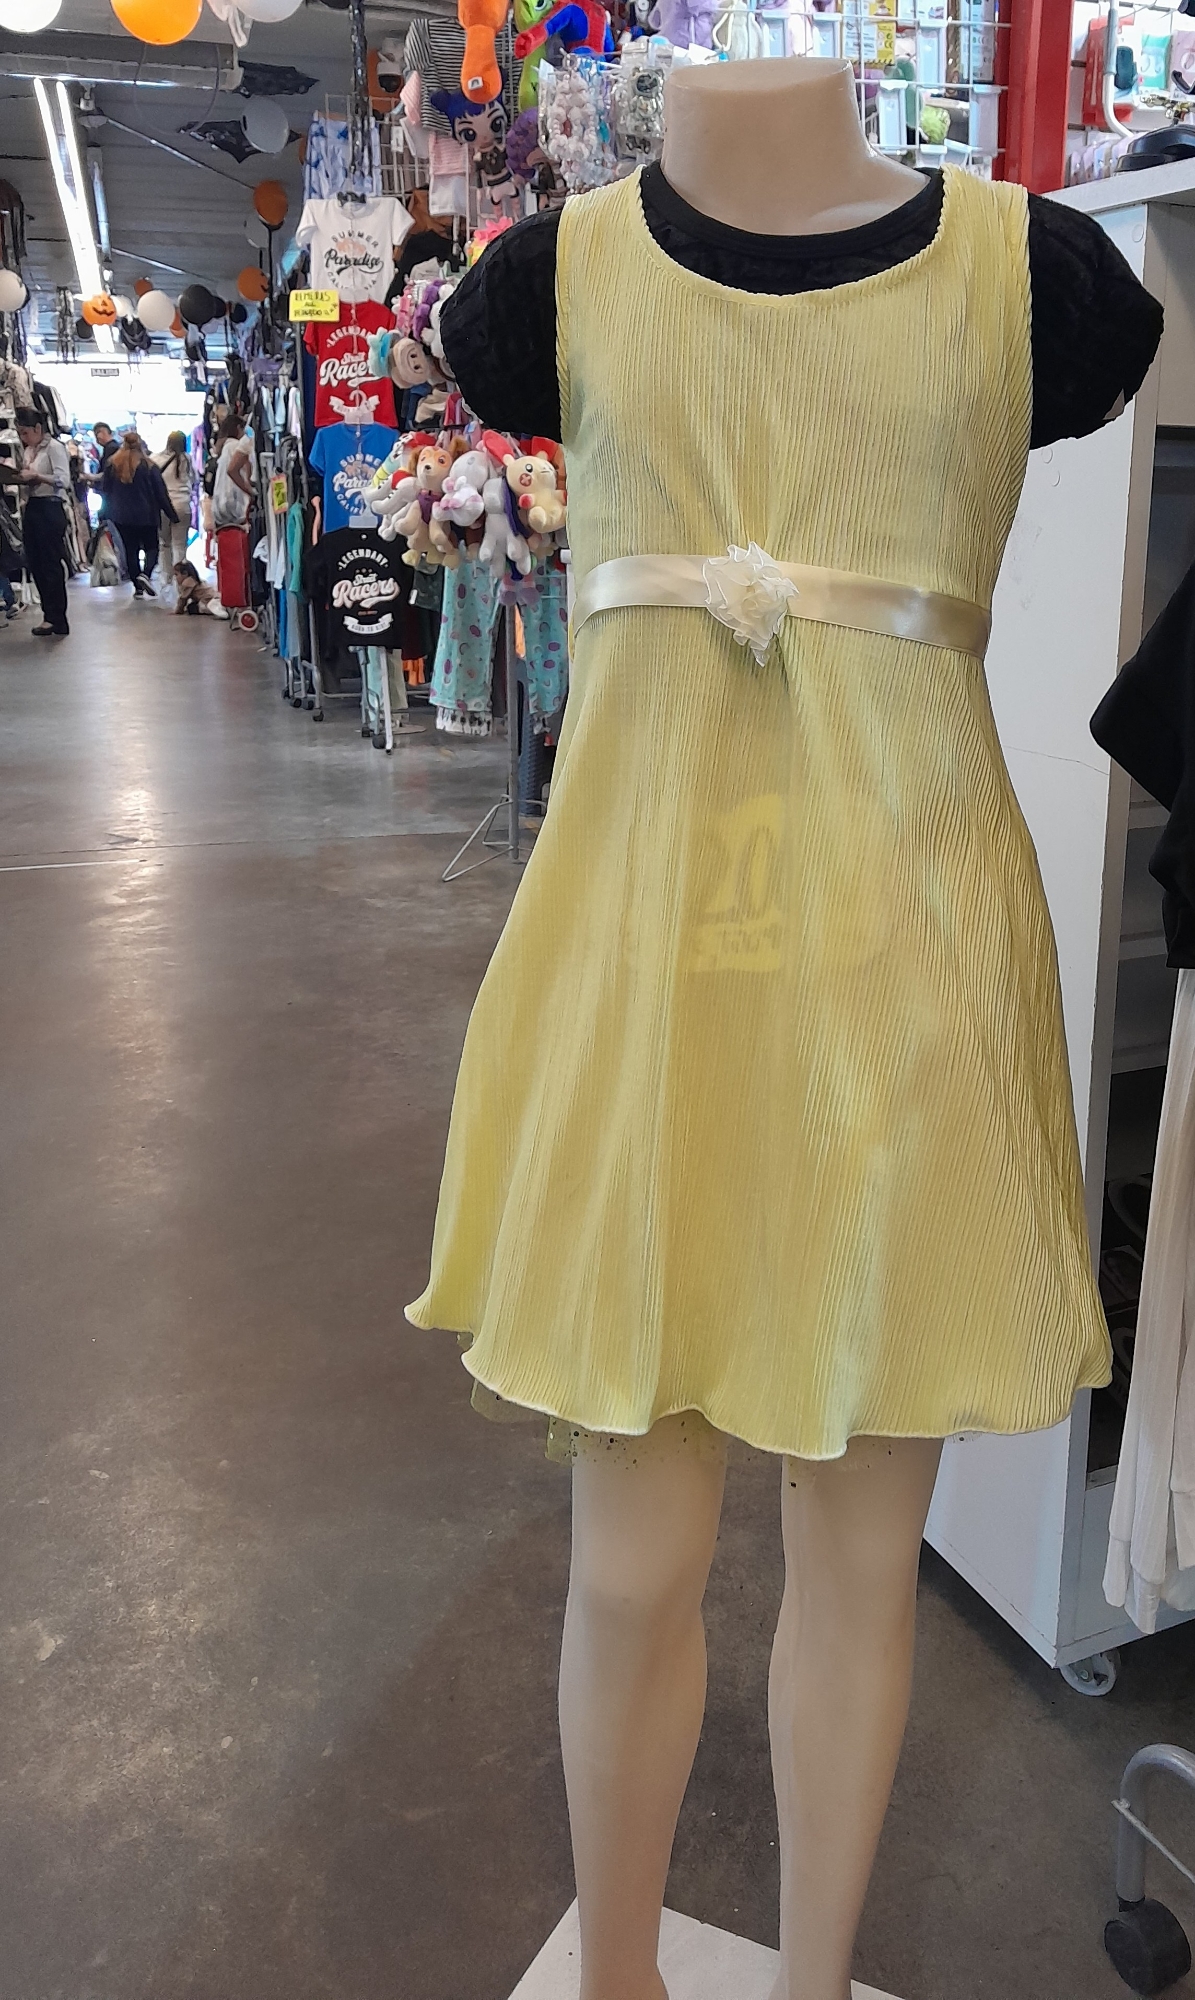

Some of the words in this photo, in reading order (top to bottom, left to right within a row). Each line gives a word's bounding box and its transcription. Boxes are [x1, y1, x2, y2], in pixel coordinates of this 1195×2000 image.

[324, 247, 384, 275] Paradise
[327, 325, 373, 348] LEGENDA
[319, 357, 371, 388] Race
[340, 453, 382, 467] SUMME
[338, 548, 389, 568] LEGENDARY
[332, 577, 400, 609] Racers
